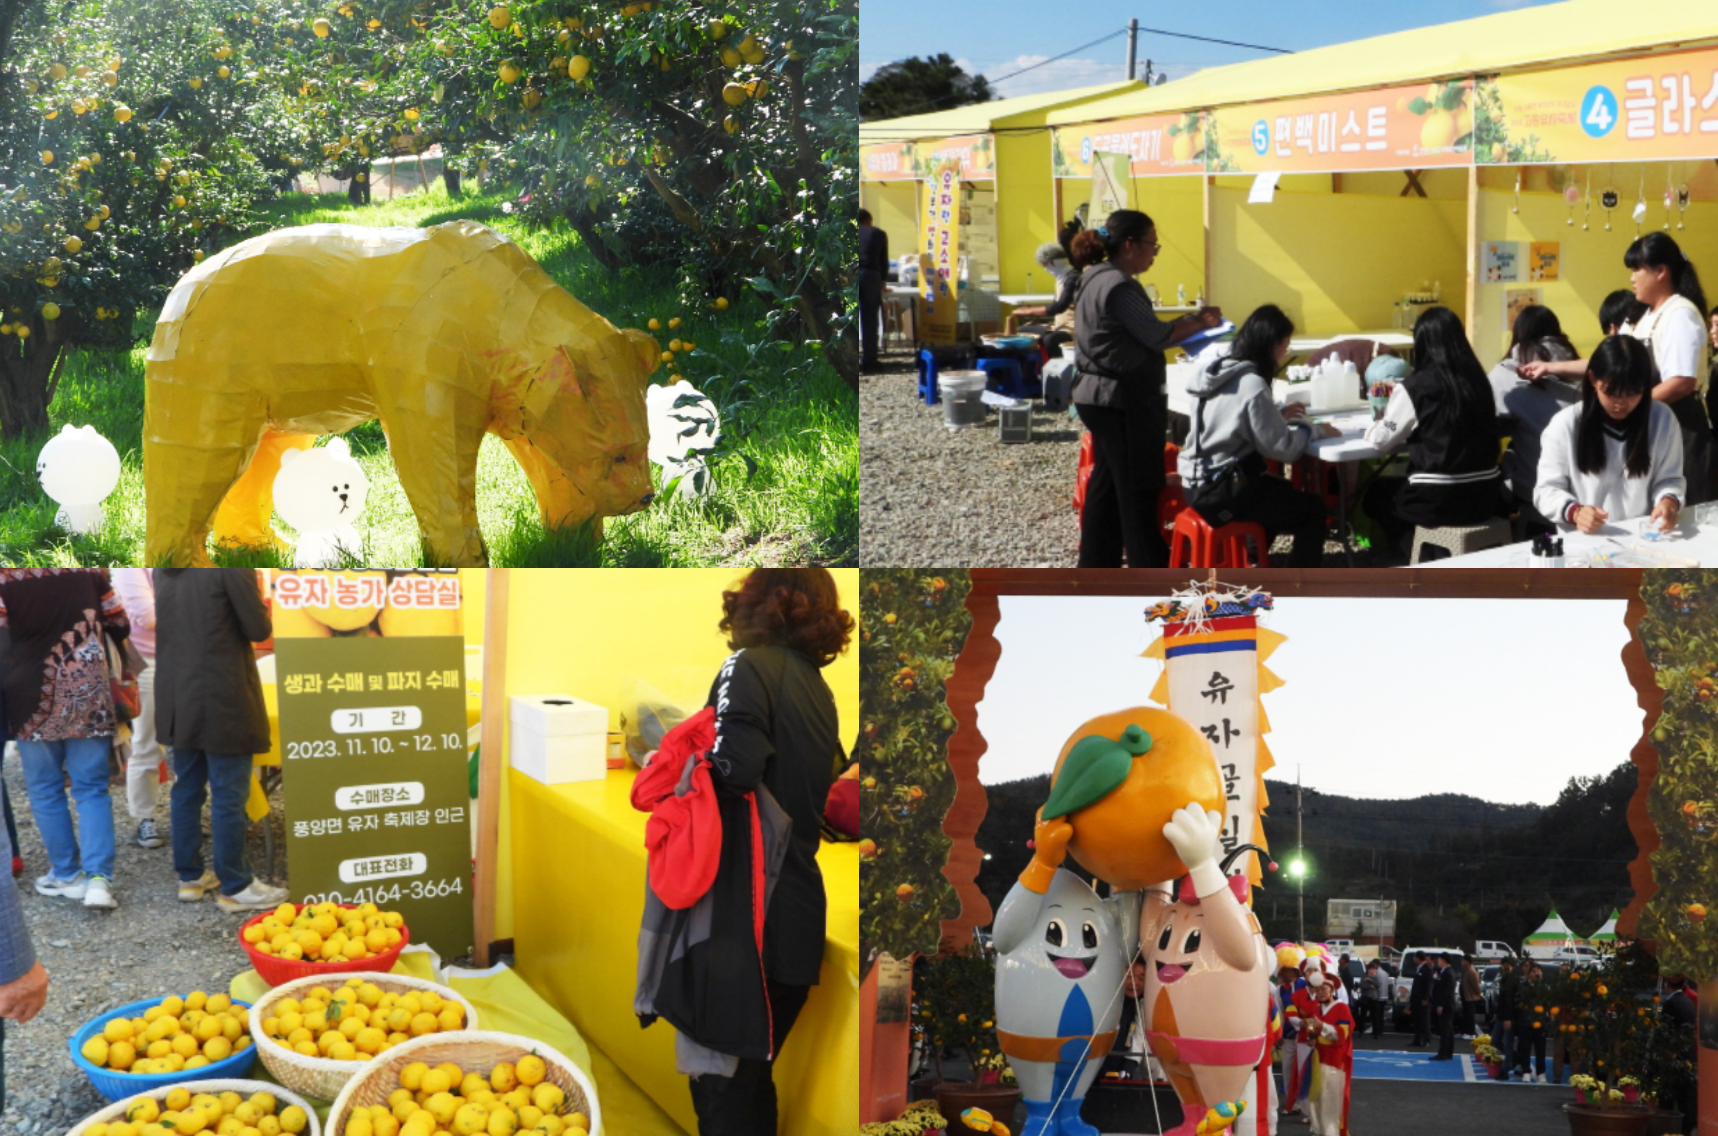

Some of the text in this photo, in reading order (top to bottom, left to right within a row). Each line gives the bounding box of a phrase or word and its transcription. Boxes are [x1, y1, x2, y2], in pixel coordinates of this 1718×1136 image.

[1586, 93, 1612, 130] 4
[1254, 124, 1267, 151] 5
[1274, 106, 1388, 157] 편백미스트
[277, 577, 458, 607] 유자 농가 상담실
[284, 669, 459, 694] 생과 수매 및 파지 수매
[287, 740, 342, 759] 2023.
[346, 739, 367, 755] 11.
[371, 737, 394, 754] 10.
[413, 735, 436, 751] 12.
[442, 733, 463, 750] 10.
[350, 787, 411, 806] 수매장소
[293, 807, 465, 838] 풍양면 유자 축제장 인근
[353, 857, 413, 877] 대표전화
